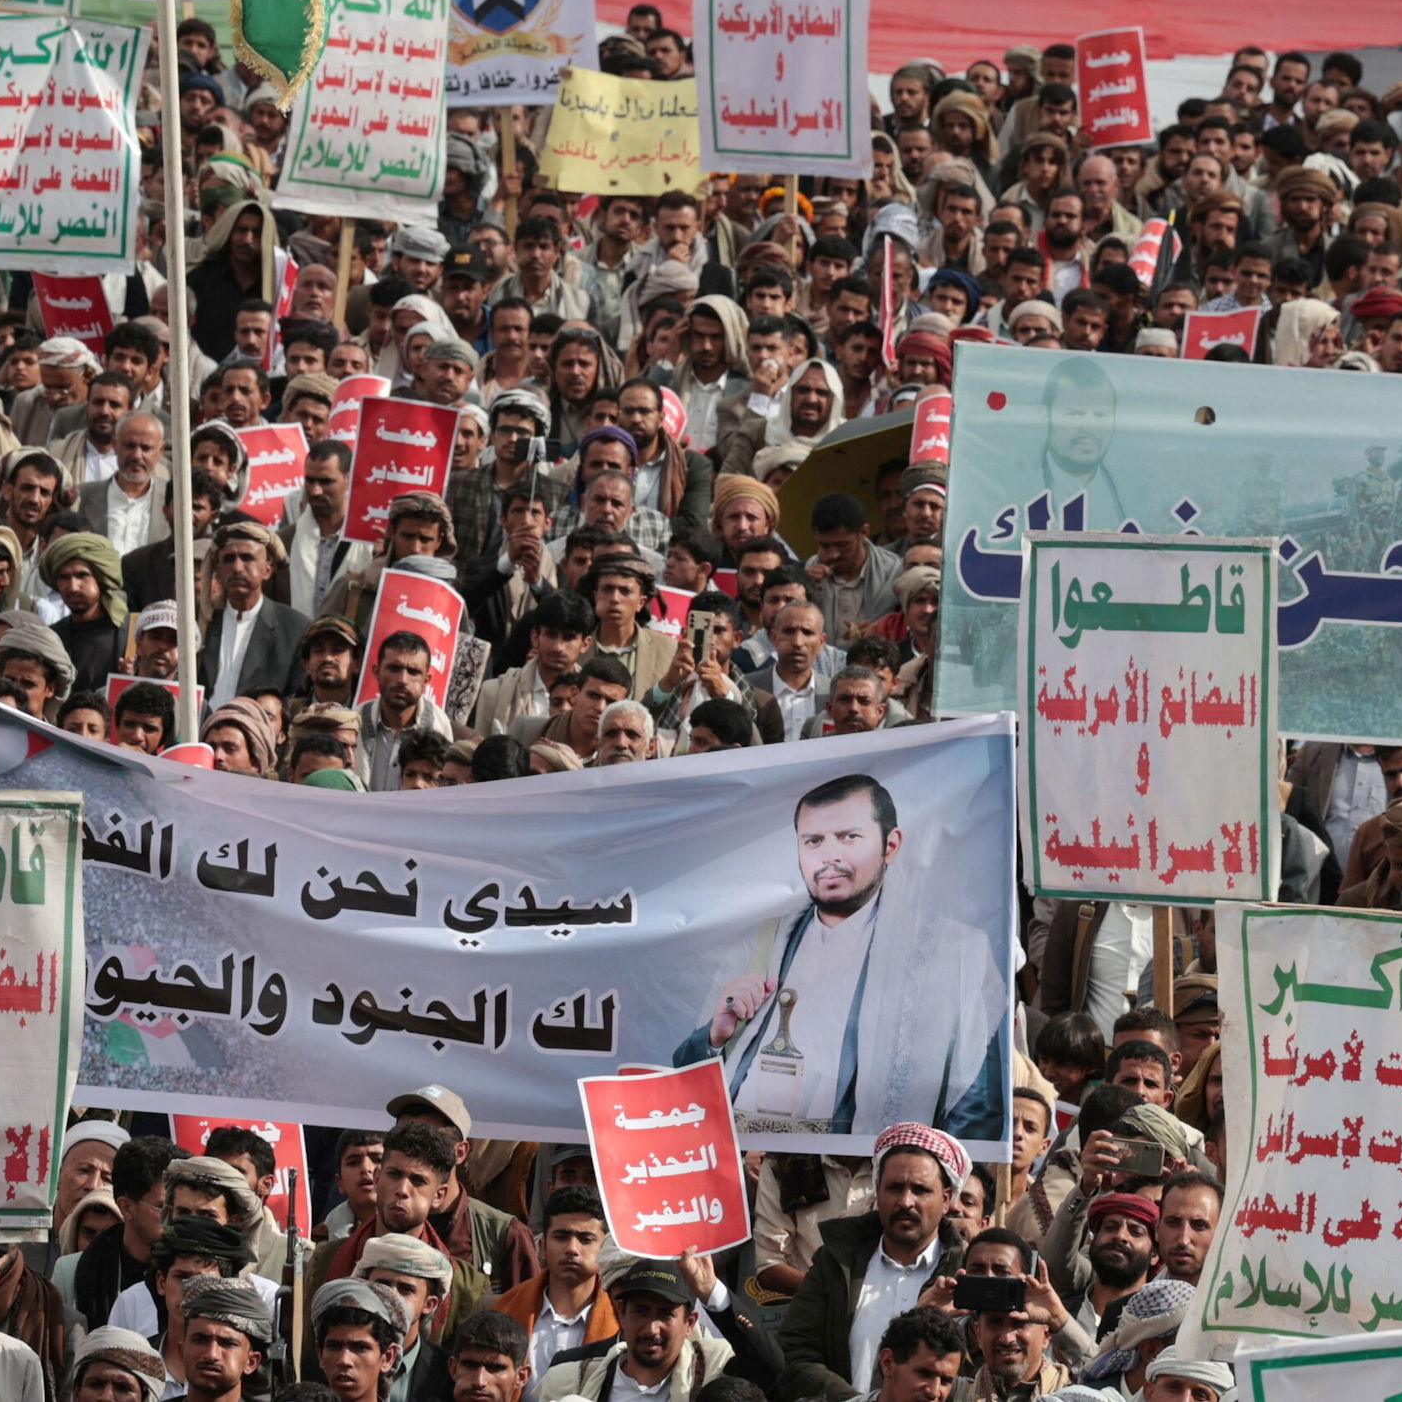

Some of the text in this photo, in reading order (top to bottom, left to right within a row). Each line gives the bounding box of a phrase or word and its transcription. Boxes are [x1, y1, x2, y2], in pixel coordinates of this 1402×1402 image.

[1051, 563, 1245, 649] قاطعوا
[1037, 659, 1257, 738] البضائع الأمريكية
[1136, 742, 1151, 796] و
[197, 839, 277, 897] لك
[1045, 814, 1259, 889] الإسرائيلية
[301, 859, 417, 919] نحن
[444, 883, 631, 946] سيدي
[85, 953, 614, 1051] لك الجنود والجيو
[613, 1103, 705, 1130] جمعة
[620, 1144, 717, 1184] التحذير
[630, 1195, 722, 1232] والنفير
